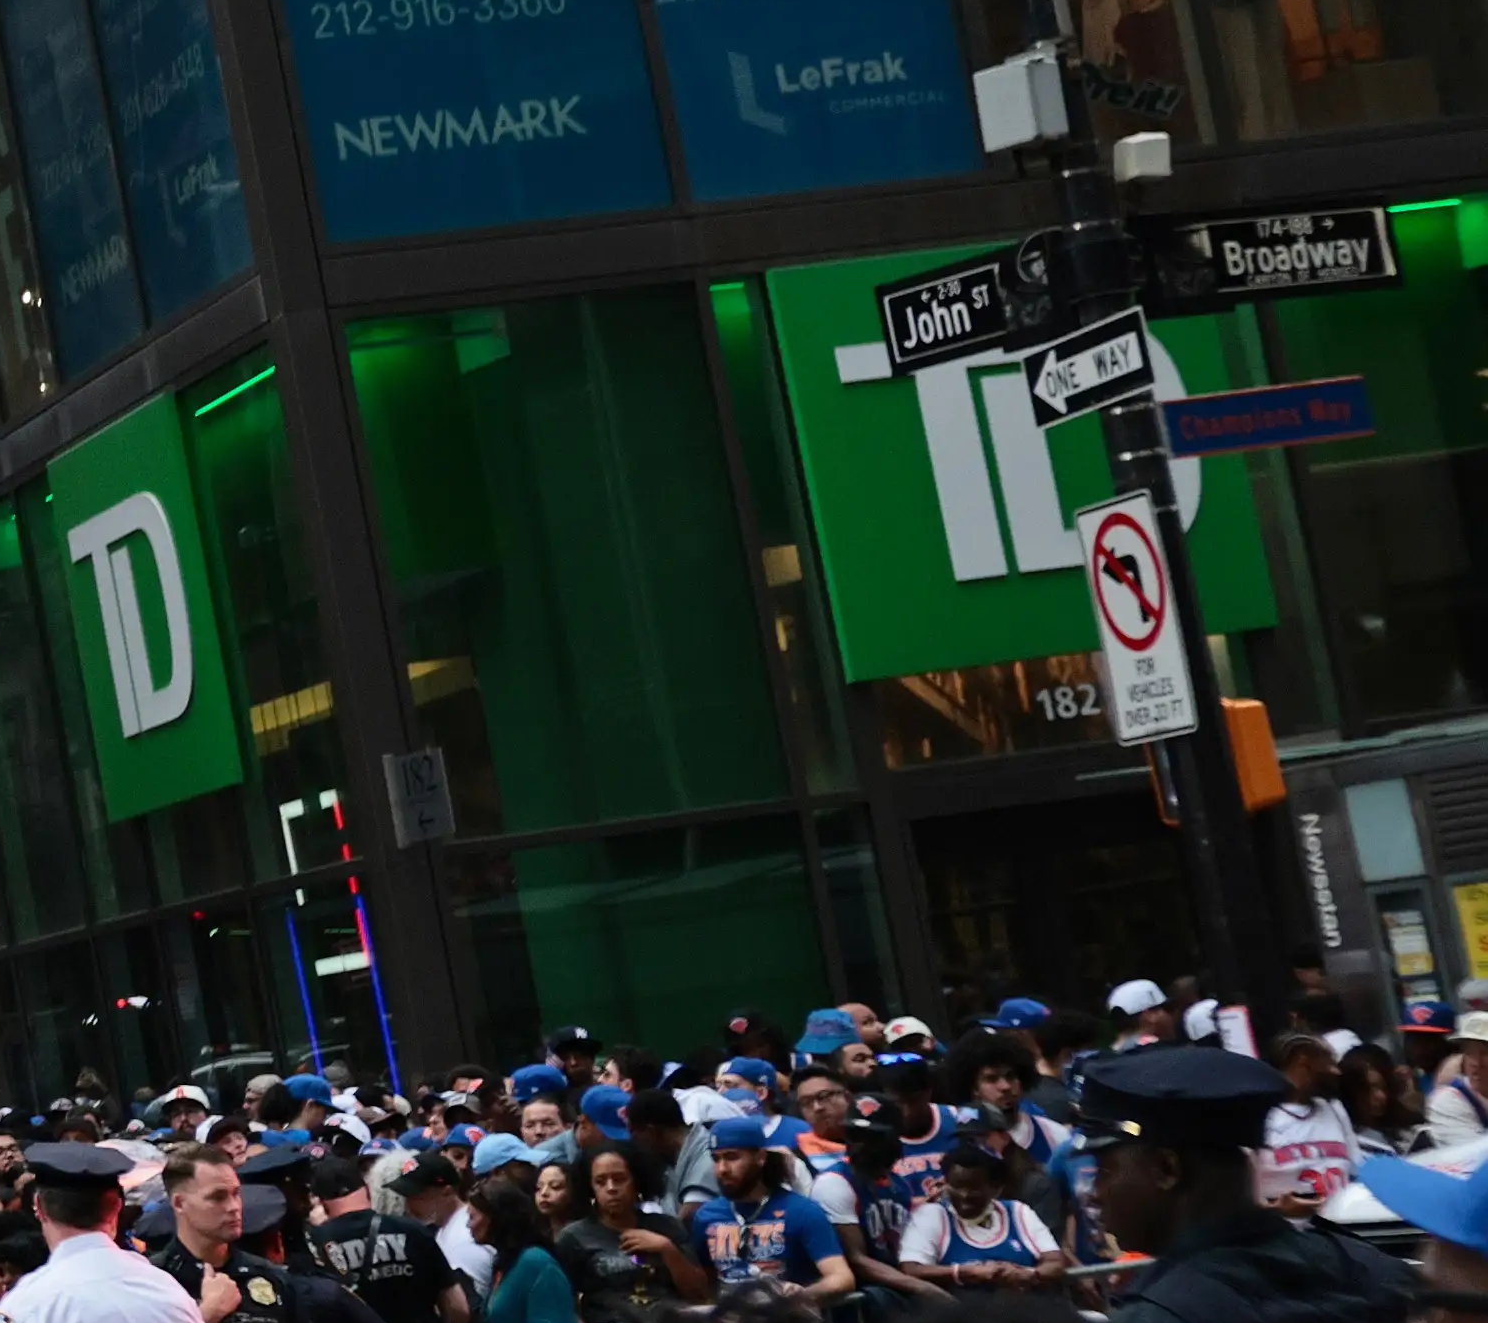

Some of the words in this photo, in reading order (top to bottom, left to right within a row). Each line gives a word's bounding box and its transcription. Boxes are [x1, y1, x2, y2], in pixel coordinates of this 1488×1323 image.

[774, 50, 909, 95] LeFrak
[334, 93, 588, 162] NEWMARK
[1222, 237, 1370, 276] Broadway
[903, 297, 972, 350] John
[971, 284, 991, 310] ST
[1044, 362, 1081, 399] ONE
[1091, 338, 1131, 380] WAY
[67, 490, 194, 740] TD
[1036, 683, 1101, 722] 182
[1127, 676, 1175, 704] VEHICLES
